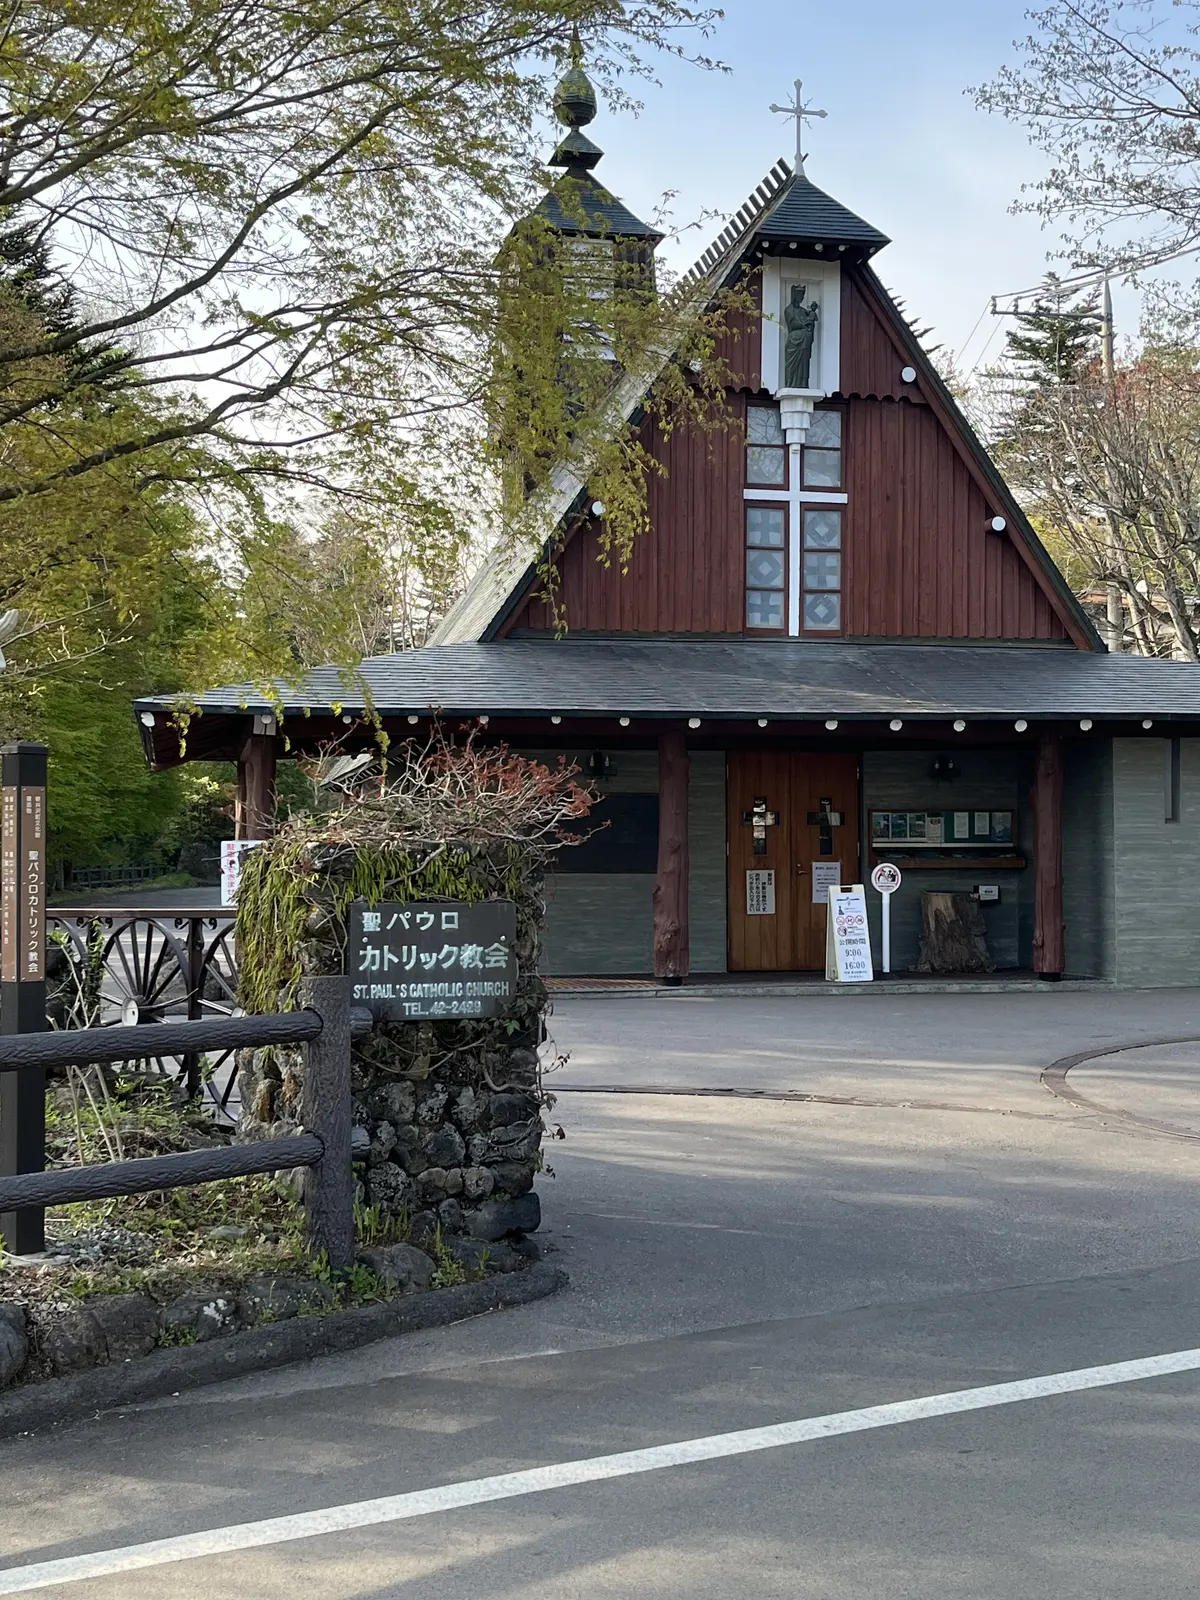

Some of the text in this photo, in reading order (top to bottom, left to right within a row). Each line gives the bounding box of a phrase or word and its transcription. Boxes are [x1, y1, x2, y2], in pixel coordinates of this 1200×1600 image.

[28, 850, 39, 973] 聖パウロカトリック教会
[361, 911, 459, 931] 聖パウロ
[359, 942, 510, 971] カトリック教会
[409, 982, 463, 998] CATHOLIC
[466, 981, 510, 996] CHURCH
